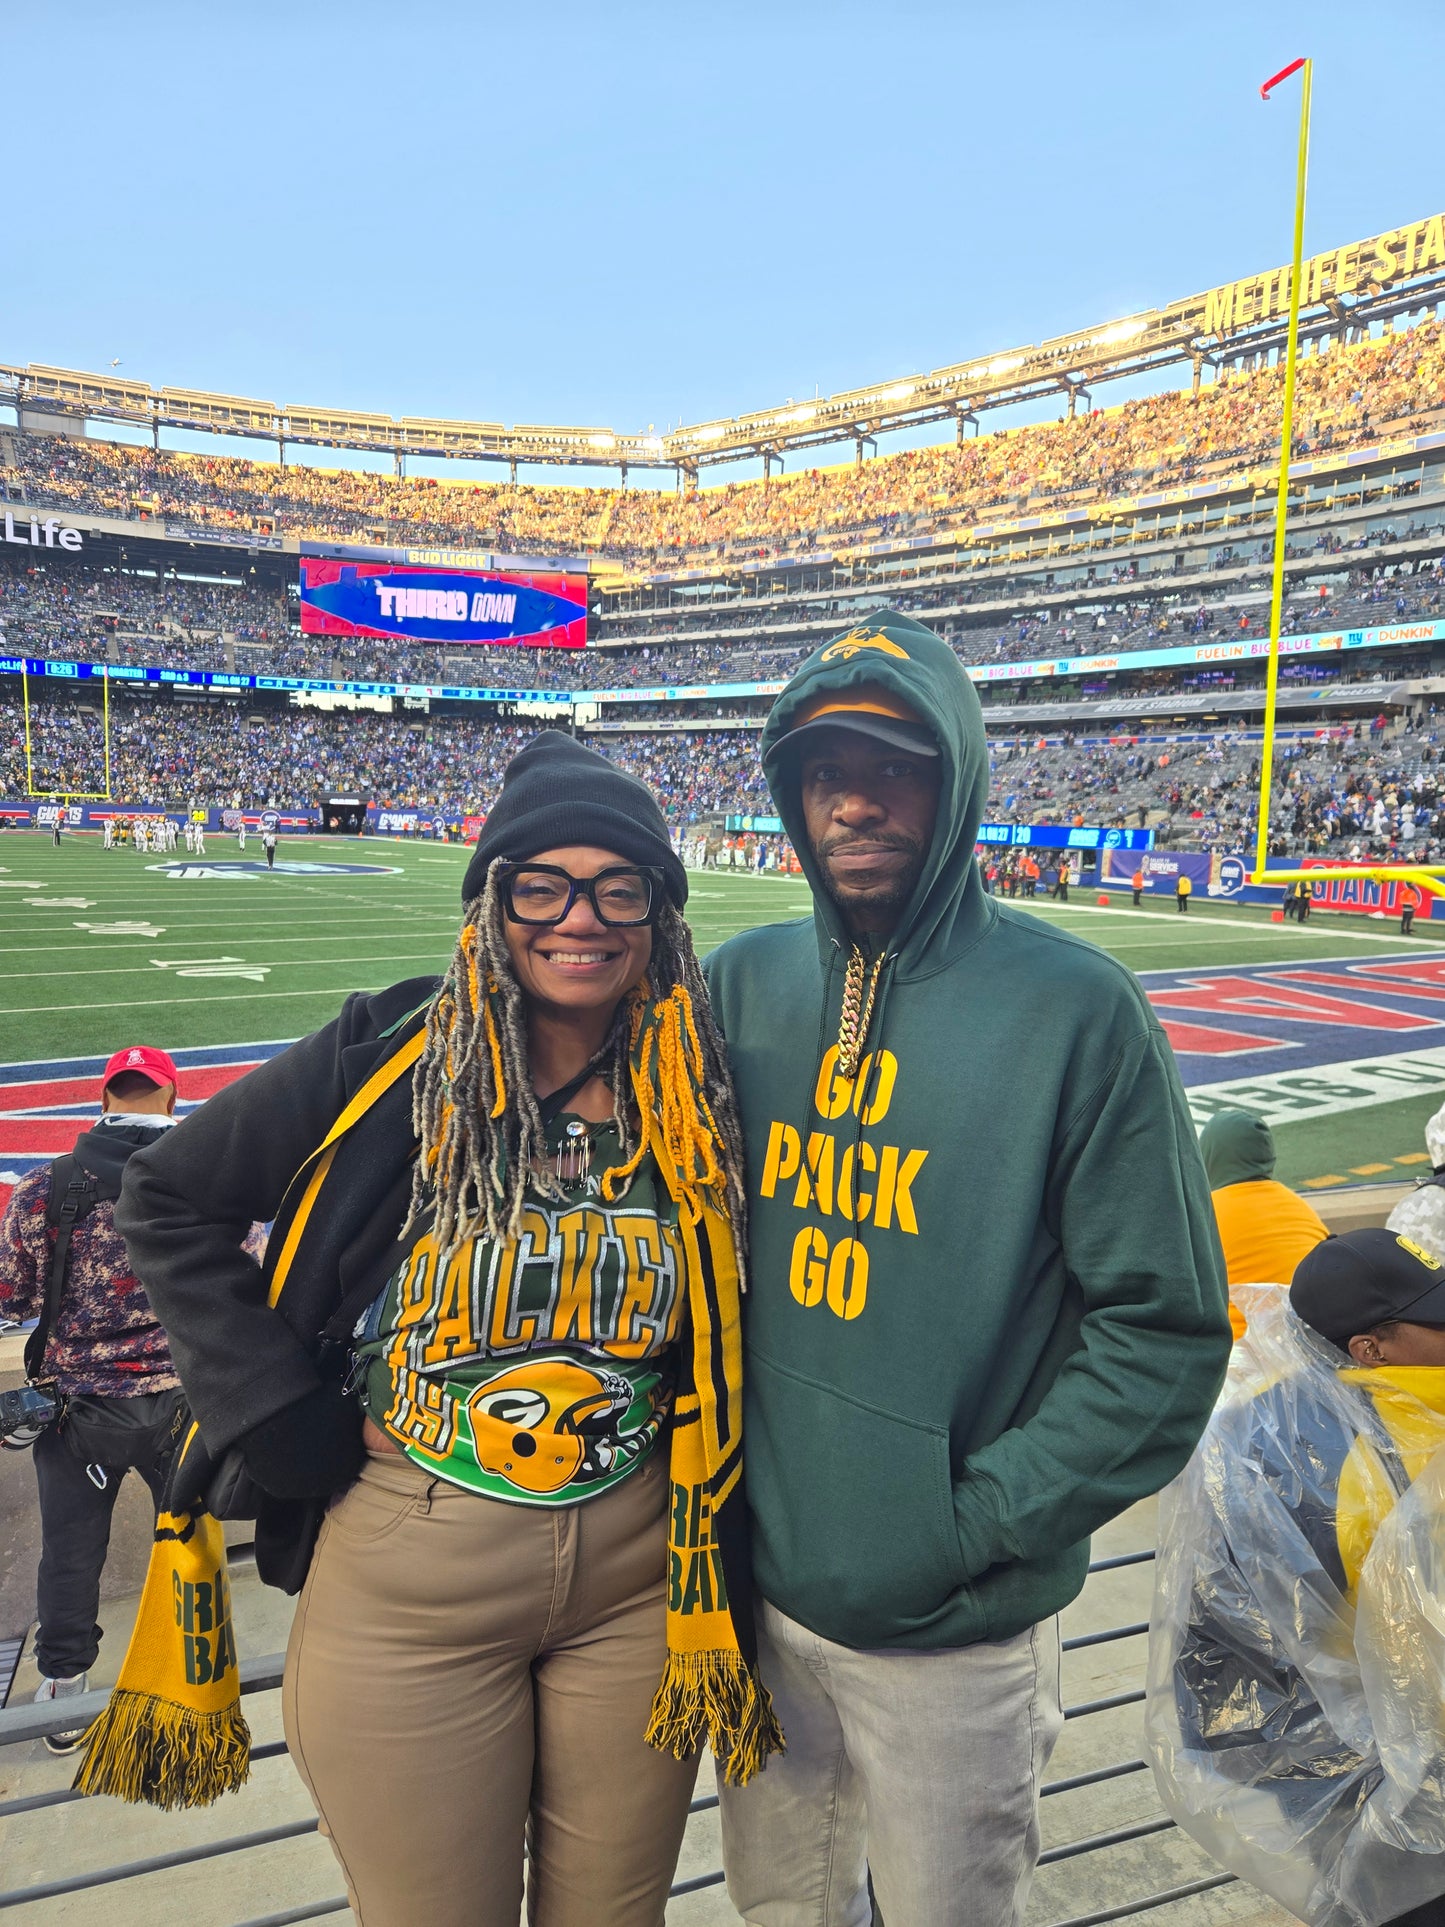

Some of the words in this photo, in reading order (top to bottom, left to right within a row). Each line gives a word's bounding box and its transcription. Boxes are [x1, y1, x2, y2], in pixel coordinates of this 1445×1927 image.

[1204, 243, 1360, 335] METLIFE
[0, 512, 83, 551] Life
[408, 551, 440, 564] BUD
[442, 553, 486, 568] LIGHT
[376, 586, 469, 622] THIRD
[470, 592, 517, 624] DOWN
[1276, 638, 1312, 652] BLUE
[50, 664, 73, 675] 0:26
[108, 667, 144, 678] QUARTER
[212, 674, 229, 684] BALL
[230, 675, 241, 684] ON
[241, 675, 250, 685] 27
[988, 667, 1005, 678] BIG
[1008, 665, 1033, 676] BLUE
[1095, 701, 1148, 713] METLIFE
[1147, 698, 1206, 711] STADIUM
[1329, 687, 1384, 698] MetLife
[1015, 826, 1031, 844] 20
[1311, 864, 1422, 908] GIANT
[815, 1043, 898, 1126] GO
[760, 1120, 929, 1235] PACK
[383, 1201, 686, 1373] PACKE
[789, 1226, 870, 1321] GO
[183, 1616, 238, 1686] BA
